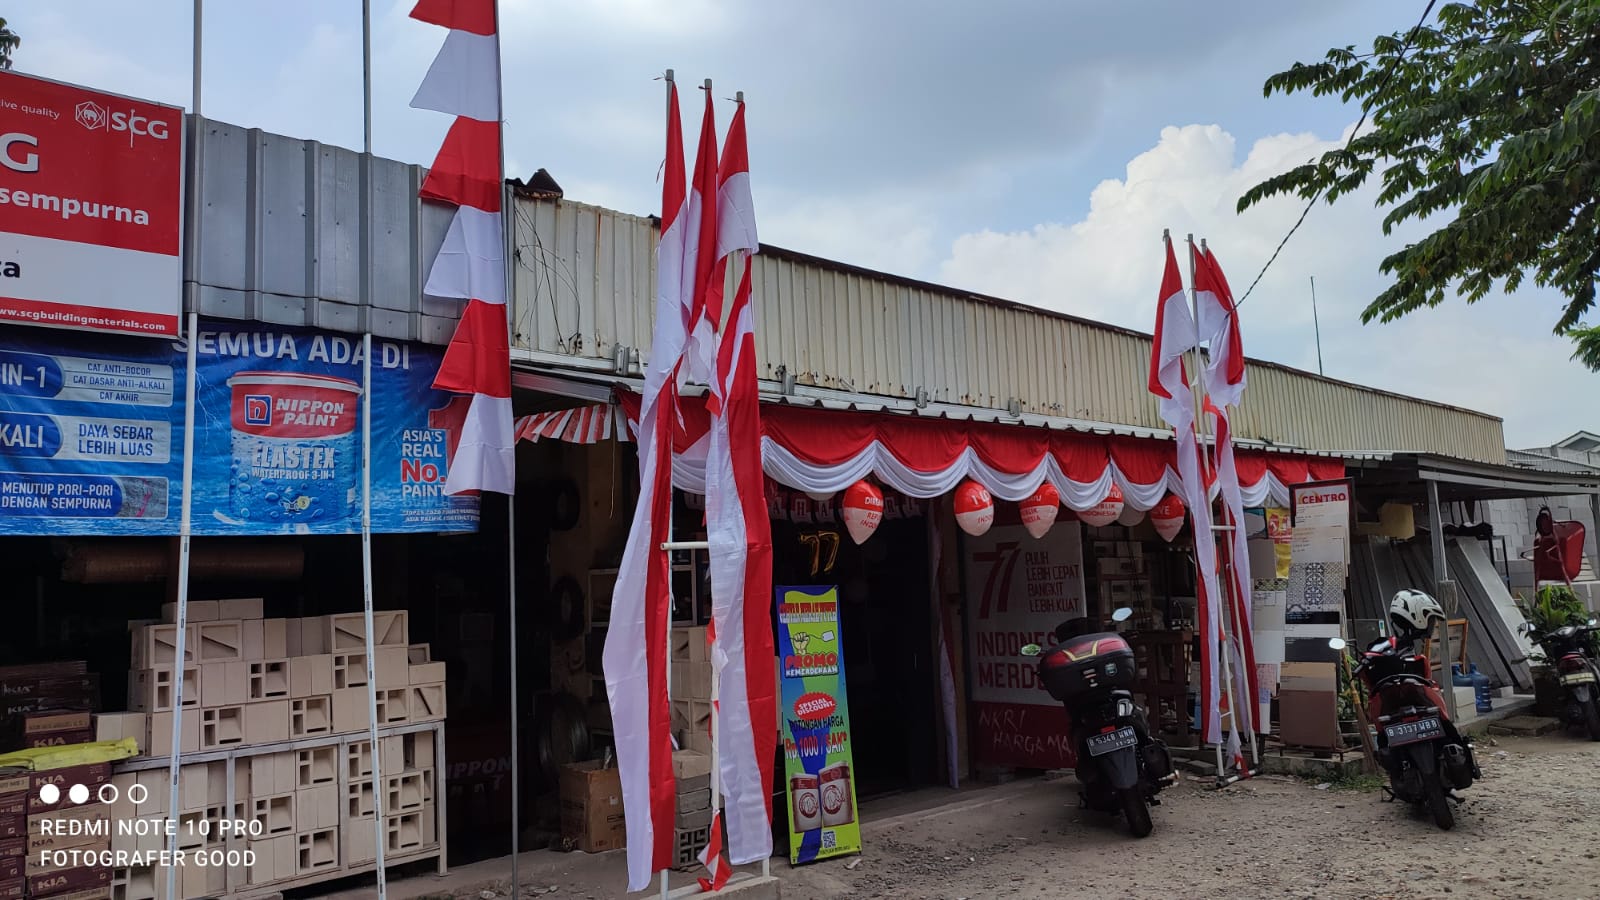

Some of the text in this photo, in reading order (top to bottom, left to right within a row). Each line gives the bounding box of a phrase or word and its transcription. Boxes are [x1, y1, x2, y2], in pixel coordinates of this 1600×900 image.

[21, 105, 60, 121] quality
[111, 110, 169, 140] SCG
[0, 133, 40, 174] G
[0, 188, 149, 225] sempurna
[382, 343, 409, 370] DI
[87, 362, 152, 377] CAT ANTI-BOCOR
[73, 375, 166, 391] CAT DASAR ANTI-ALKALI
[99, 391, 139, 403] CAT AKHIR
[276, 398, 345, 416] NIPPON
[283, 412, 338, 428] PAINT
[79, 423, 154, 441] DAYA SEBAR
[402, 429, 443, 442] ASIA'S
[78, 438, 153, 457] LEBIH LUAS
[401, 443, 443, 458] REAL
[251, 446, 336, 470] ELASTEX
[251, 469, 335, 481] WATERPROOF 3-IN-1
[401, 458, 446, 482] No.
[2, 481, 114, 497] MENUTUP PORI-PORI
[402, 484, 446, 498] PAINT
[1, 496, 112, 510] DENGAN SEMPURNA
[1302, 492, 1347, 505] CENTRO
[800, 529, 841, 577] 77
[1025, 551, 1049, 565] PULIH
[973, 541, 1020, 620] 77
[1027, 565, 1080, 580] LEBIH CEPAT
[1028, 582, 1063, 597] BANGKIT
[1030, 597, 1080, 613] LEBIH KUAT
[785, 652, 838, 670] PROMO
[823, 715, 845, 729] HARGA
[993, 732, 1045, 756] HARGA
[35, 774, 65, 786] KIA
[37, 876, 68, 890] KIA
